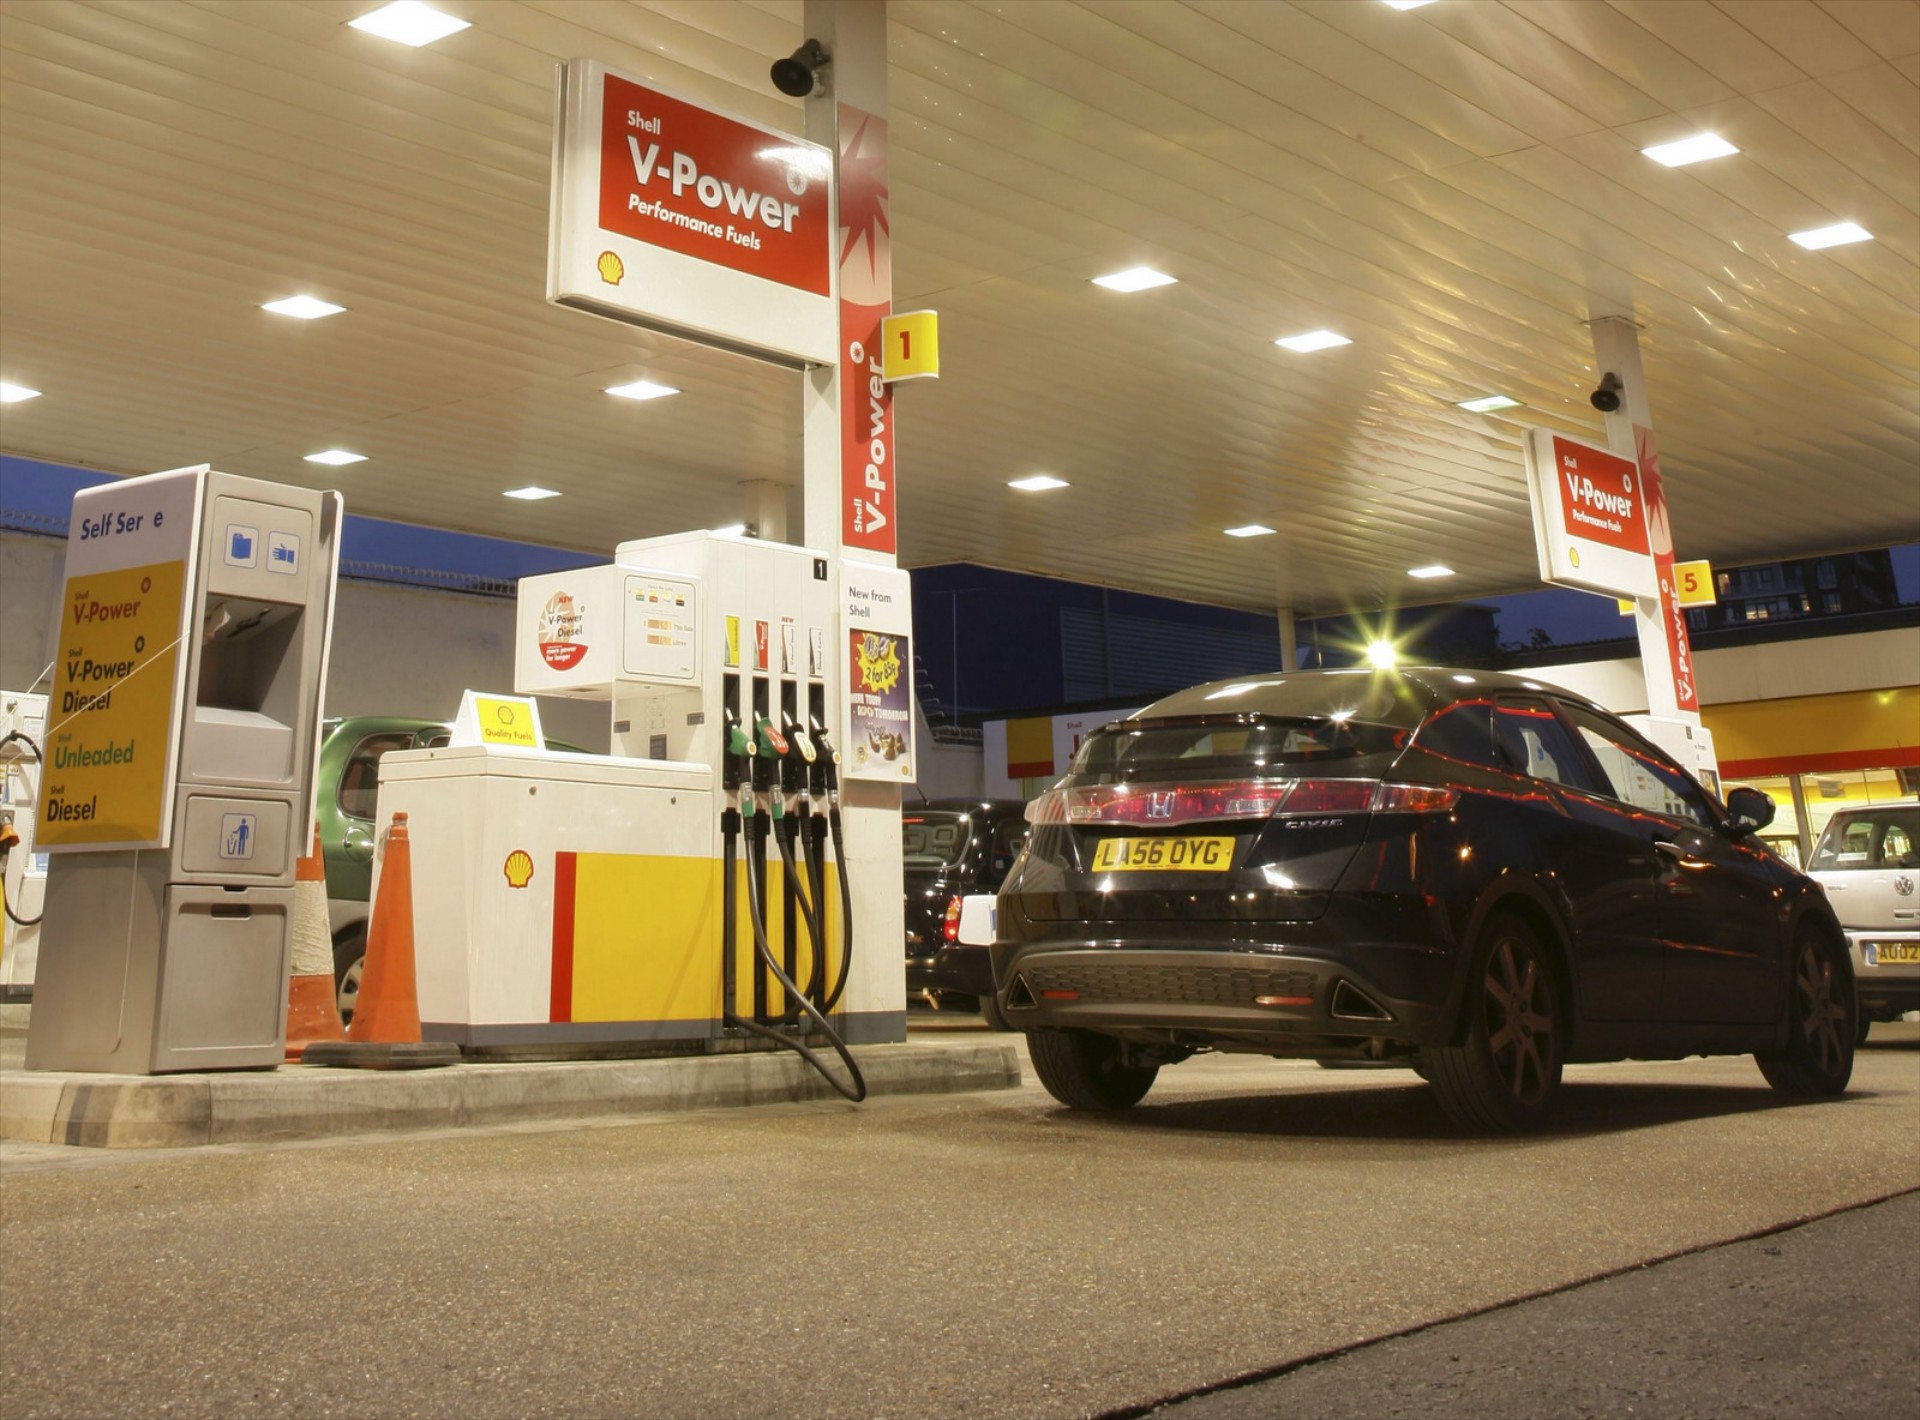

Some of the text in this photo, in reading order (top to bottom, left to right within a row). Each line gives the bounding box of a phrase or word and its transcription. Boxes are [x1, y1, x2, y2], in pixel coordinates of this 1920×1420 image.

[628, 110, 661, 135] Shell
[627, 136, 800, 234] V-Power
[628, 193, 761, 251] Performance Fuels
[899, 331, 910, 361] 1
[865, 356, 887, 534] V-Power
[1566, 471, 1632, 519] V-Power
[80, 512, 113, 541] Self
[853, 498, 863, 534] Shell
[1572, 508, 1608, 530] Performance
[817, 561, 824, 579] 1
[1684, 573, 1698, 592] 5
[849, 586, 892, 603] New from
[73, 598, 141, 625] V-Power
[548, 614, 583, 626] V-Power
[849, 604, 871, 618] Shell
[558, 625, 583, 637] Diesel
[66, 657, 135, 684] V-Power
[865, 666, 872, 681] 2
[872, 666, 883, 683] for
[62, 685, 112, 714] Diesel
[485, 727, 532, 741] Quality Fuels
[54, 739, 135, 770] Unleaded
[47, 795, 97, 823] Diesel
[1101, 840, 1165, 867] LA56
